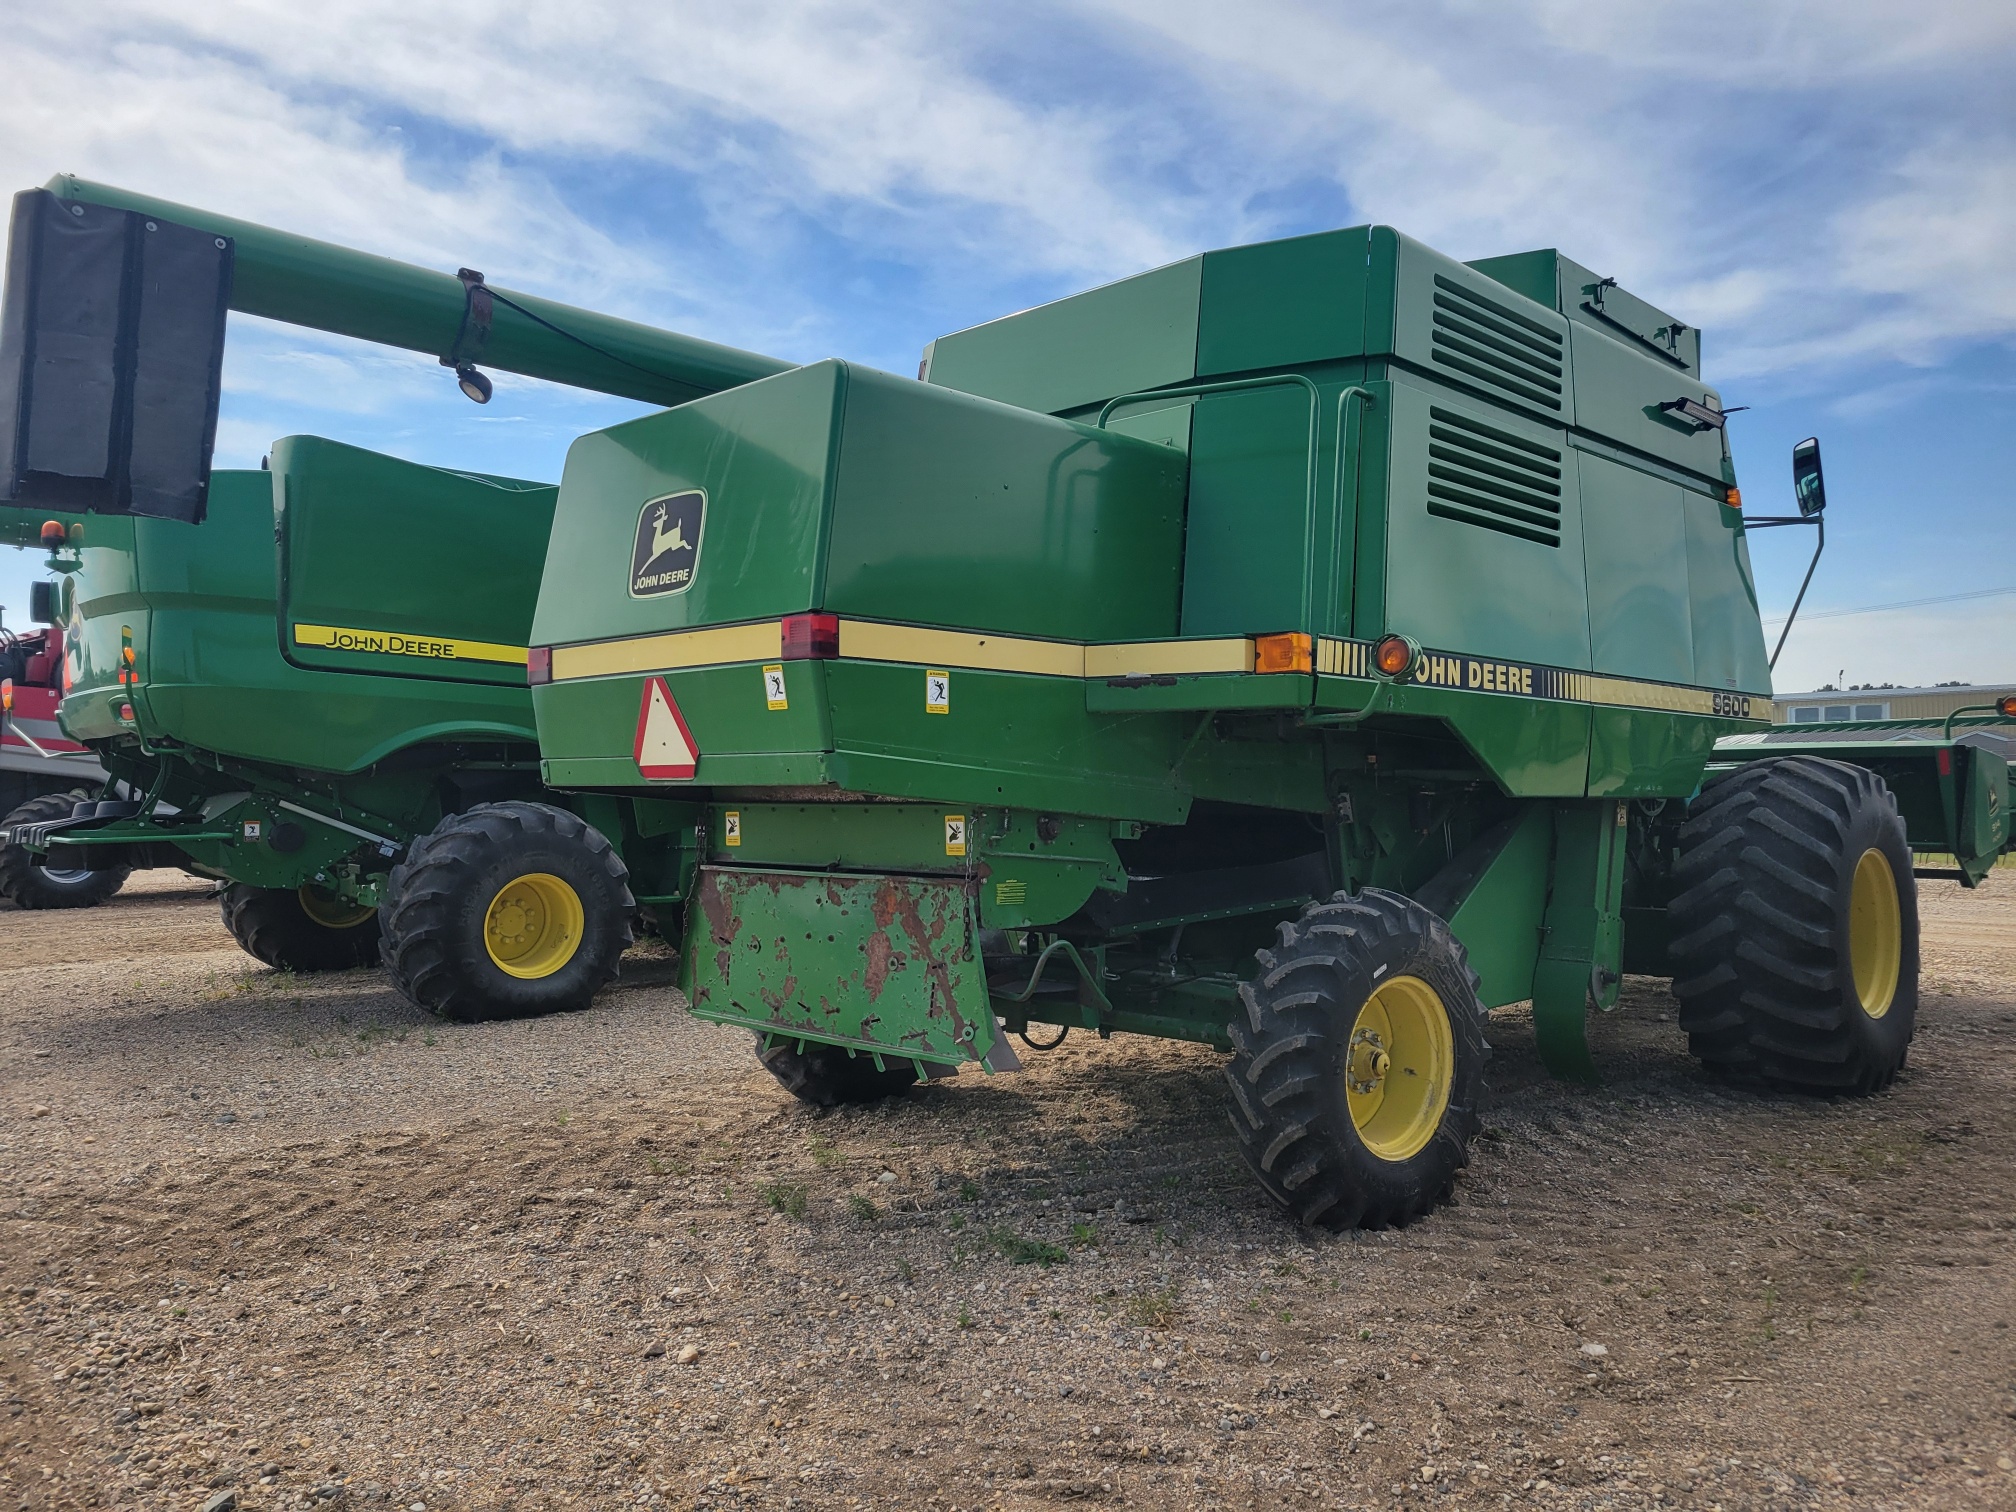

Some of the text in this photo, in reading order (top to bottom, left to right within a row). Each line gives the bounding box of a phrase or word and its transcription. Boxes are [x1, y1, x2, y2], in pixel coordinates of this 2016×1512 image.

[634, 568, 690, 590] JOHN DEERE
[325, 631, 455, 656] JOHN DEERE
[1409, 654, 1533, 694] OHN DEERE
[1712, 693, 1750, 717] 9600
